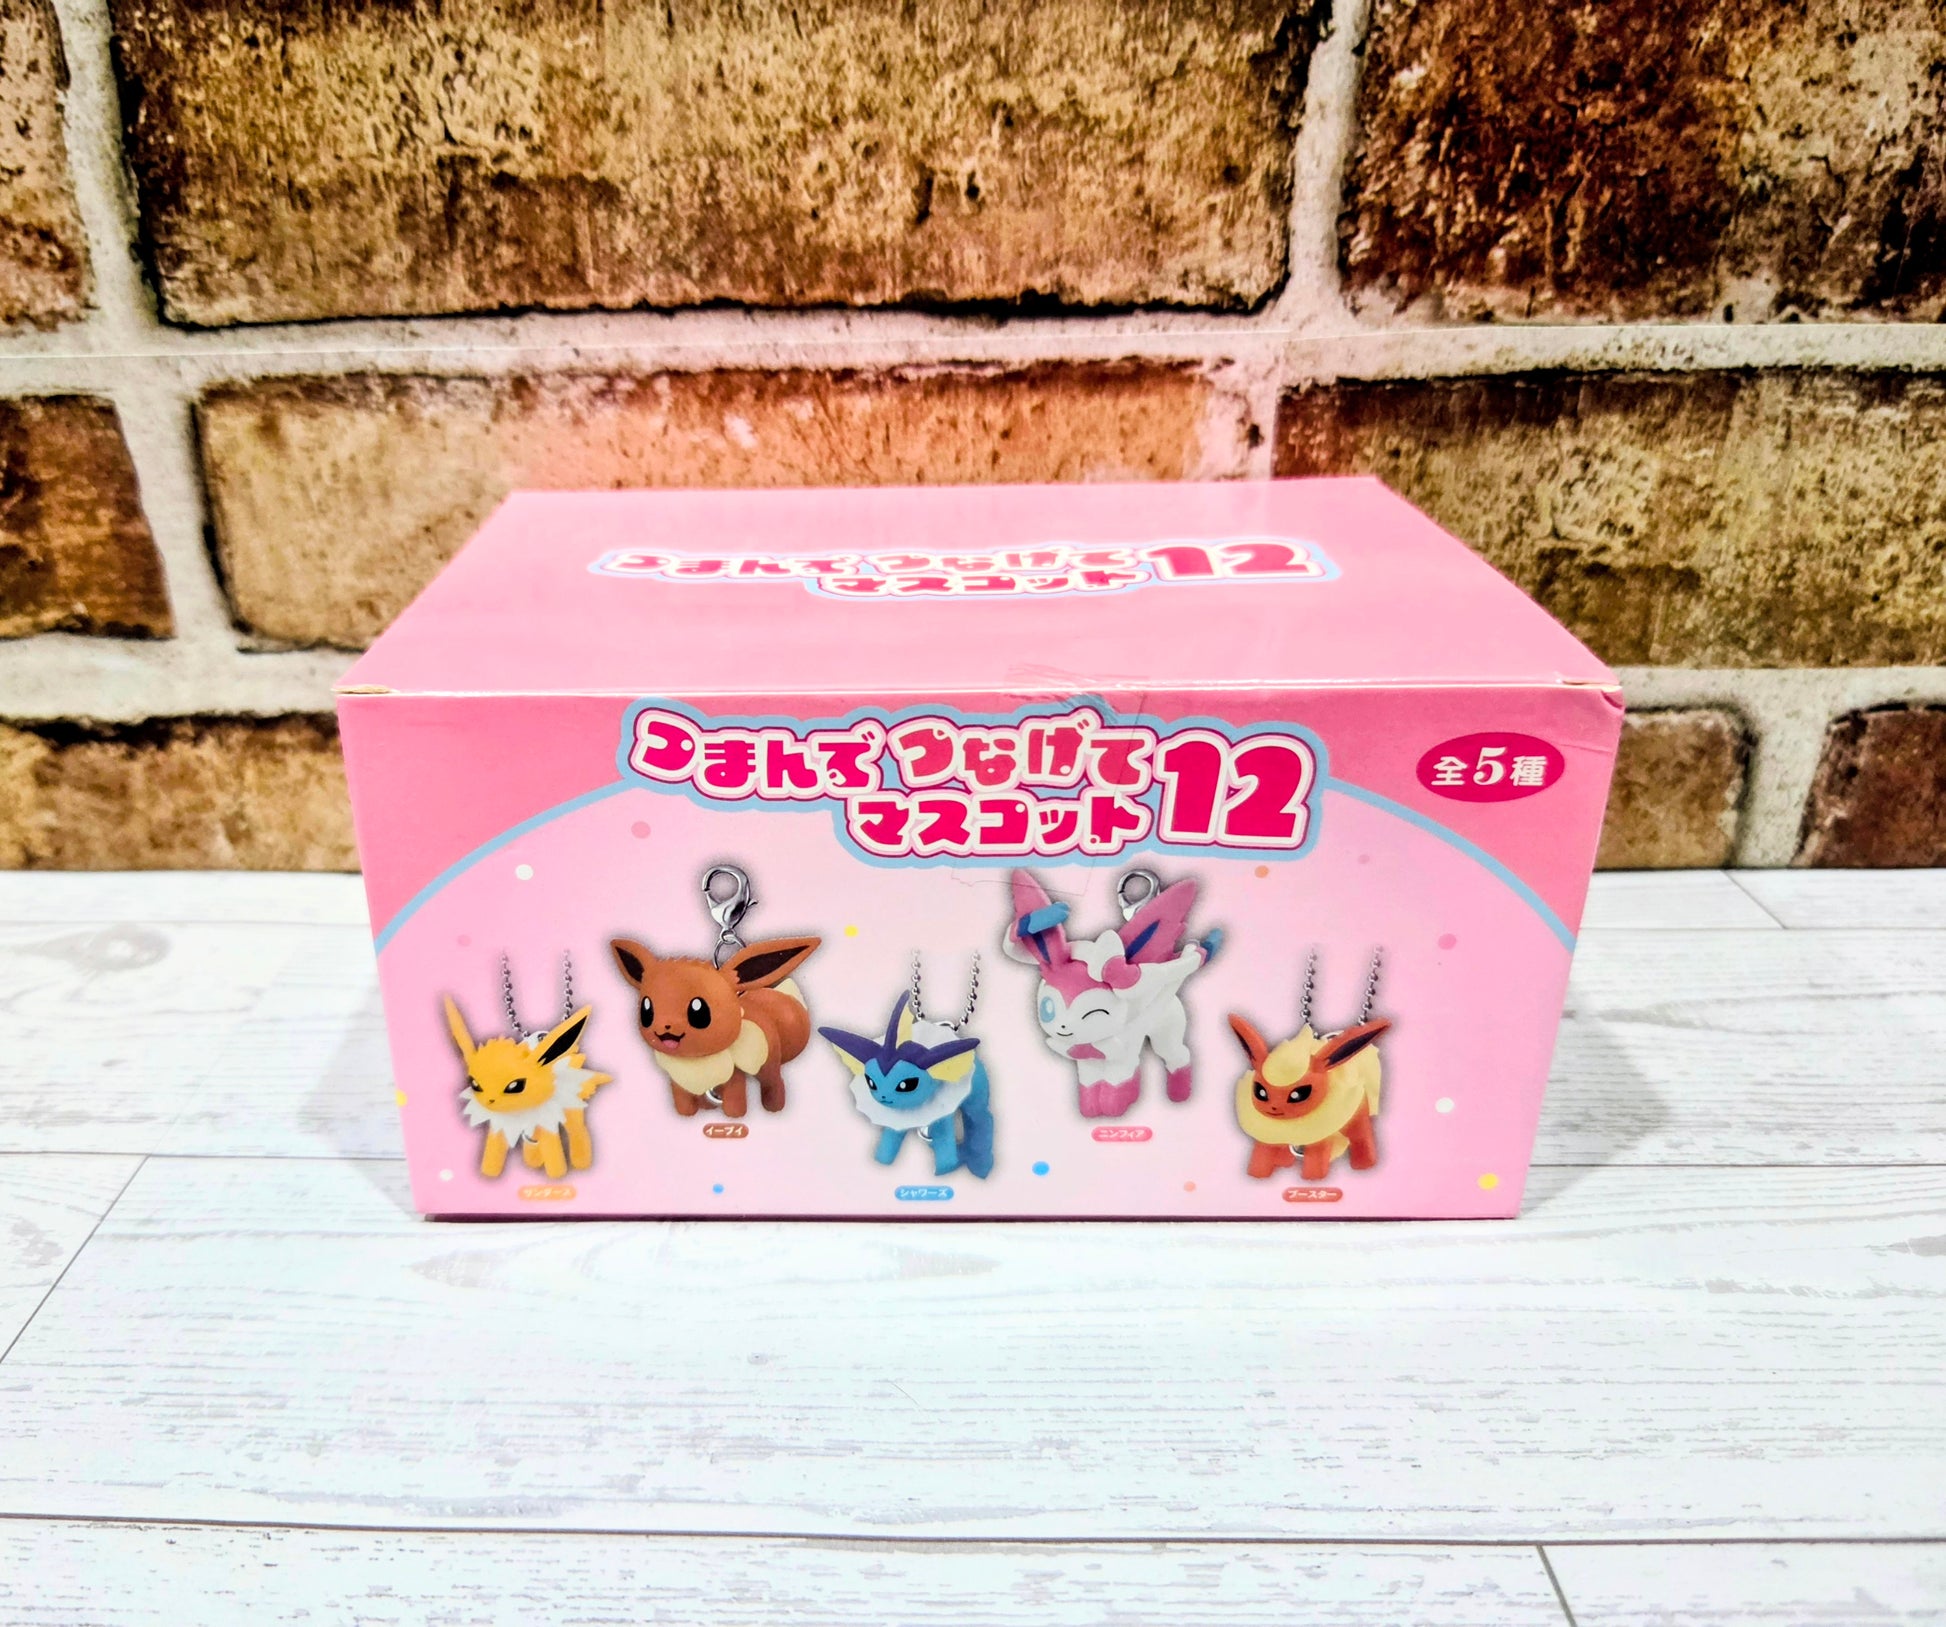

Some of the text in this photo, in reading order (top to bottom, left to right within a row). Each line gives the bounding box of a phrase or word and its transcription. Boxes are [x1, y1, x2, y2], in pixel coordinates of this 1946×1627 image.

[1147, 543, 1311, 578] 12
[643, 716, 1150, 790] つまんで つなげて
[1430, 746, 1548, 787] 全5種
[858, 738, 1303, 847] マスコット 12
[704, 1124, 744, 1137] イーブイ
[1098, 1128, 1146, 1140] ニンフィア
[899, 1187, 949, 1199] シャワーズ
[1287, 1188, 1338, 1200] ブースター
